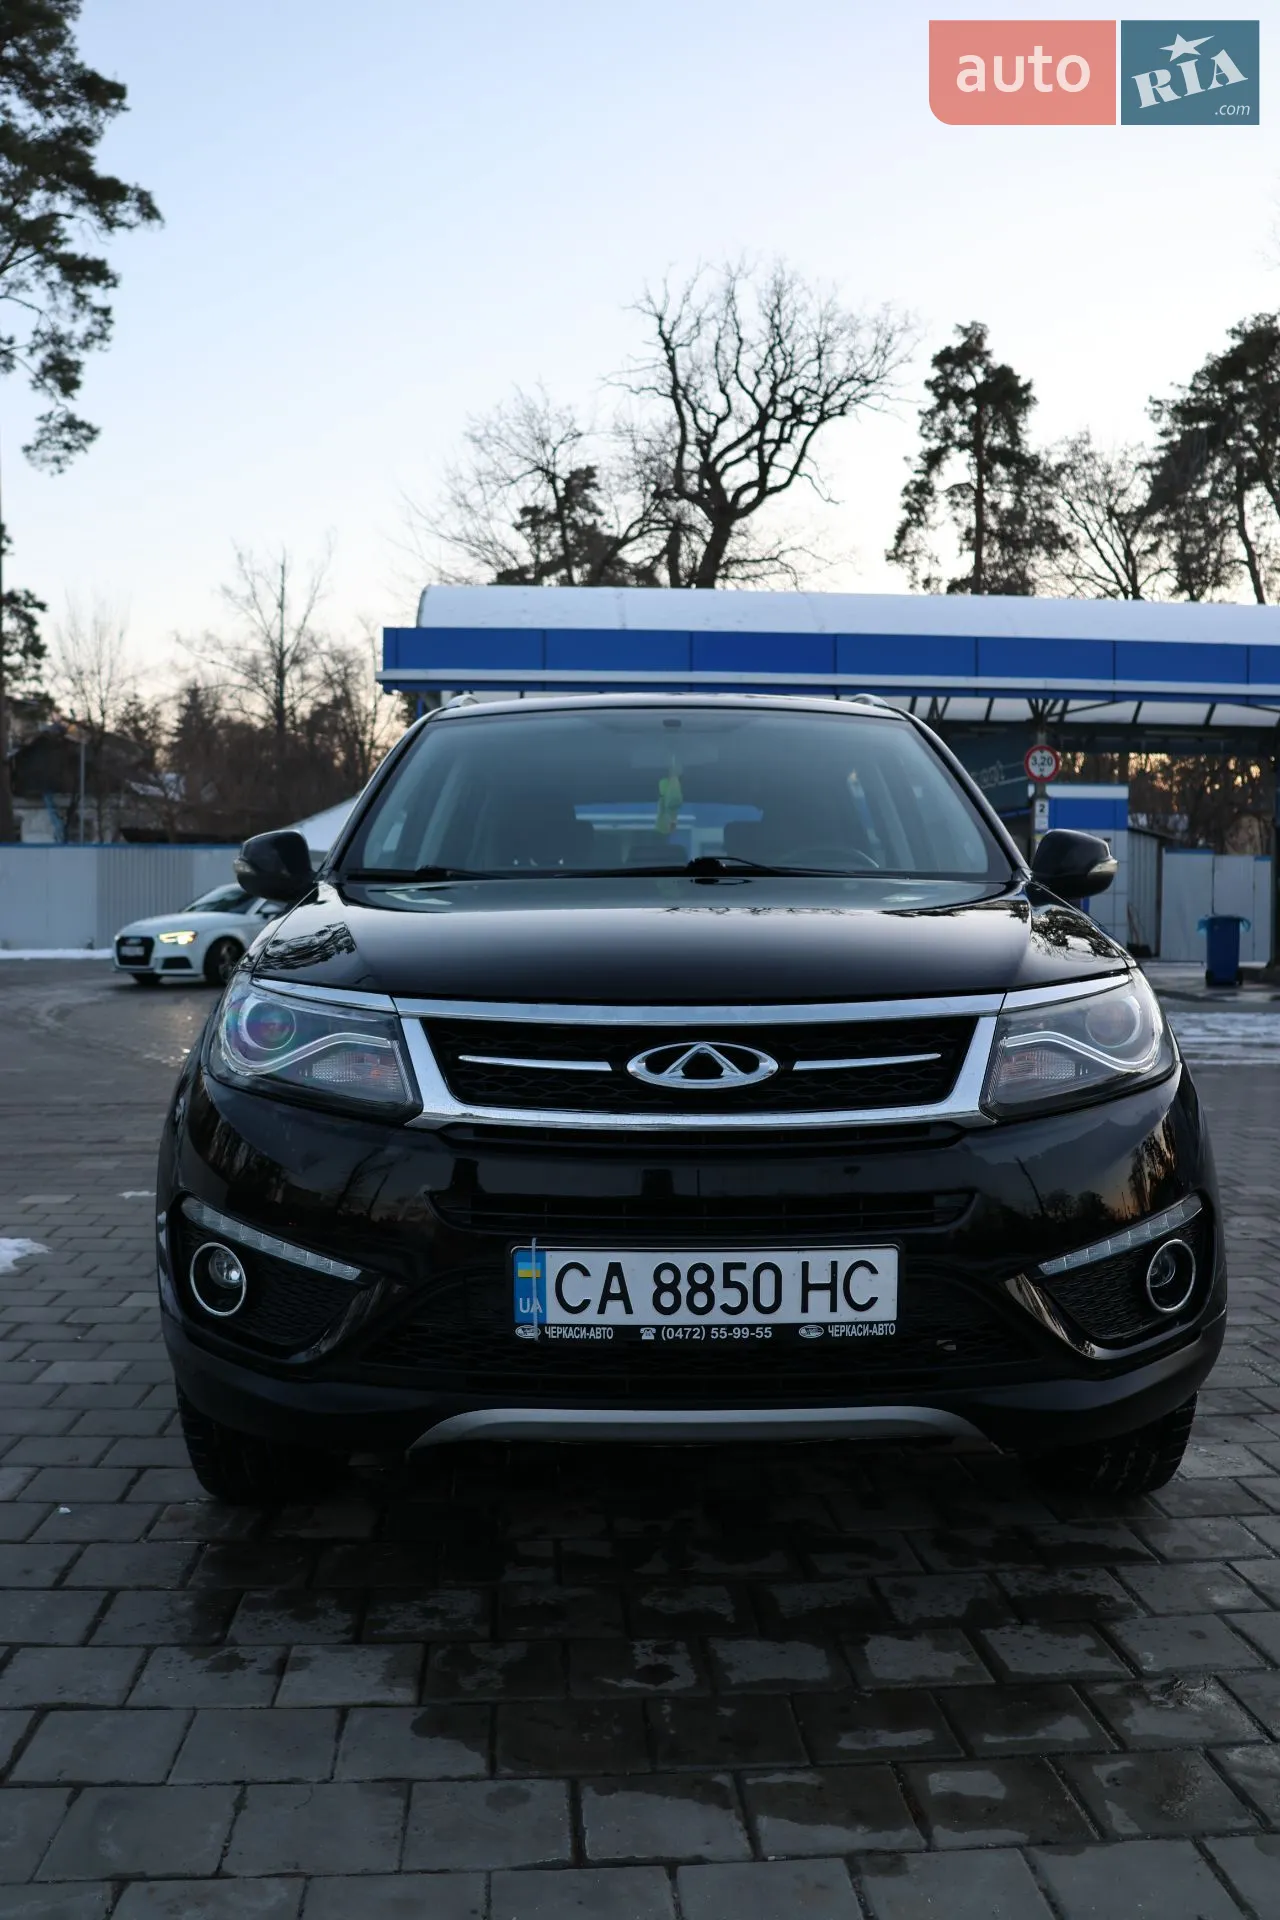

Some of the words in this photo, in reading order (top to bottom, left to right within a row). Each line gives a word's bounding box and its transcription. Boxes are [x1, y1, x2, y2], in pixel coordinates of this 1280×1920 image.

[1039, 804, 1046, 813] 2
[554, 1261, 634, 1316] CA
[652, 1261, 783, 1316] 8850
[801, 1259, 879, 1314] HC
[519, 1297, 543, 1315] UA
[544, 1326, 614, 1340] ЧЕРКАСИ-АВТО
[661, 1326, 706, 1341] (0472)
[710, 1326, 773, 1340] 55-99-55
[828, 1323, 896, 1338] ЧЕРКАСИ-АВТО
